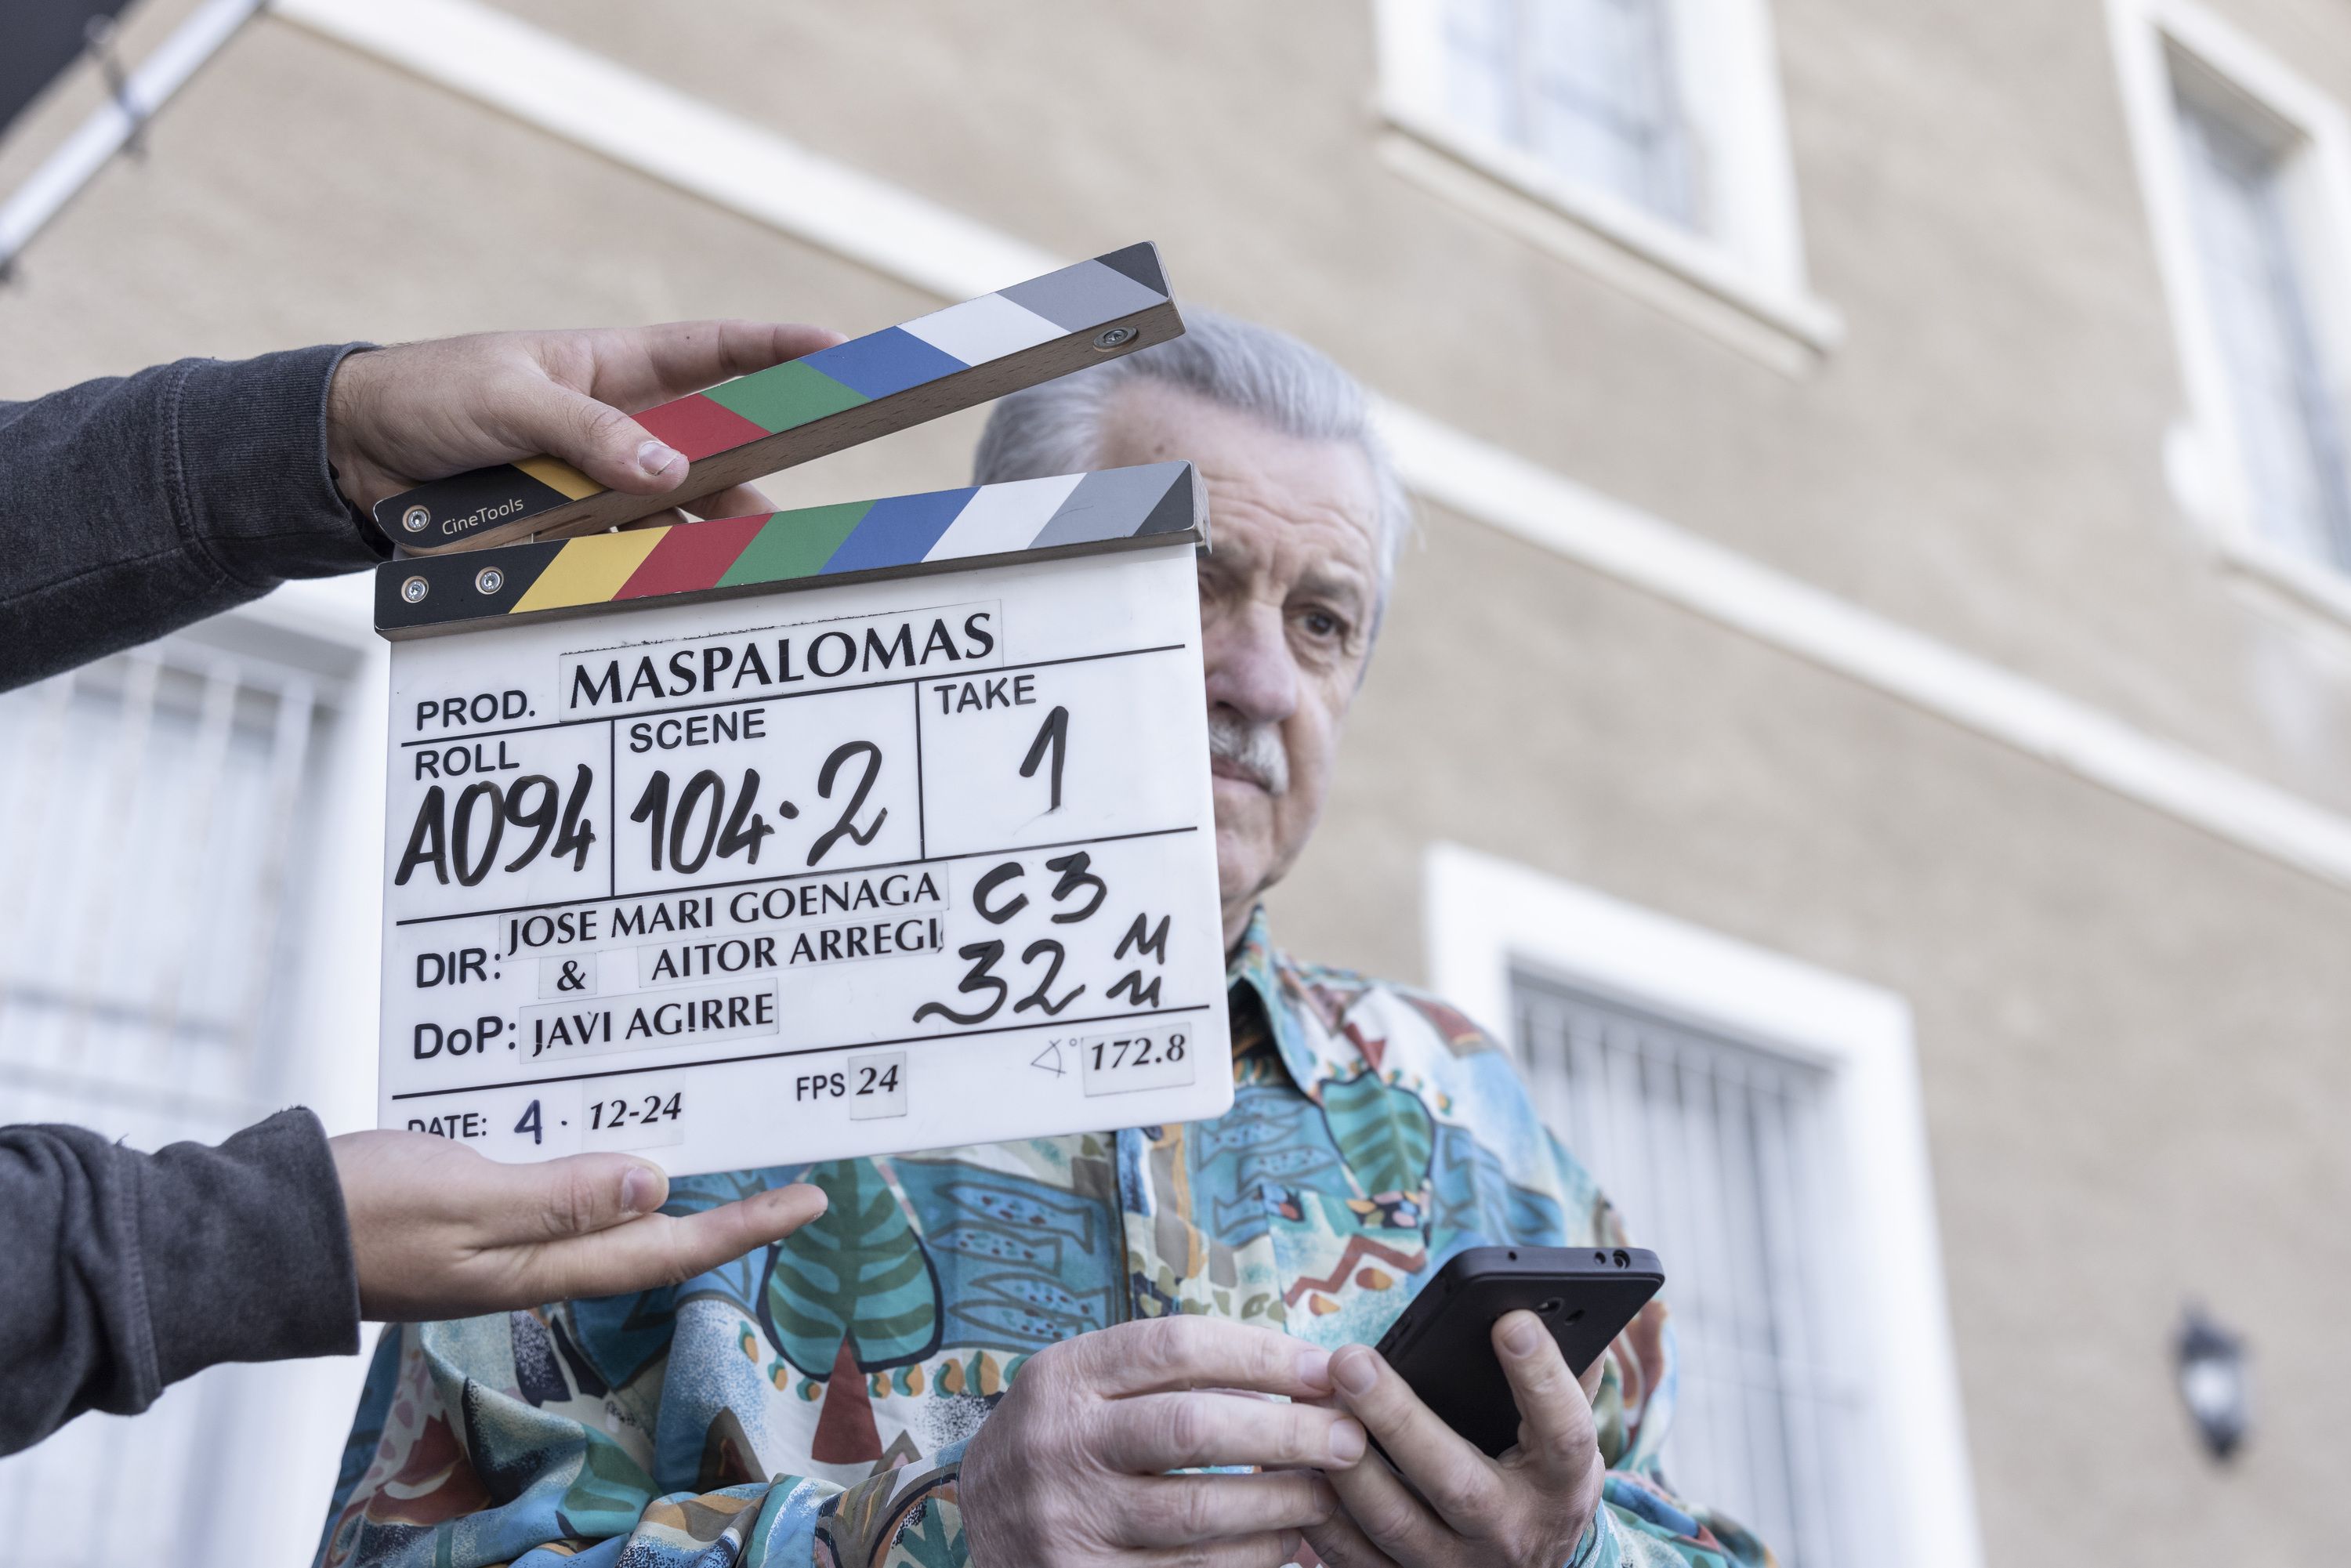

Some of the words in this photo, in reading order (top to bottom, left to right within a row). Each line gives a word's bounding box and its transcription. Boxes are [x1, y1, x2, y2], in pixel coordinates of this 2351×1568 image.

[441, 498, 523, 534] CineTools
[416, 690, 536, 731] PROD.
[570, 612, 994, 709] MASPALOMAS
[933, 674, 1037, 715] TAKE
[629, 708, 766, 753] SCENE
[415, 741, 520, 780] ROLL
[1019, 706, 1069, 814] 1
[394, 763, 596, 885] A094
[507, 910, 597, 956] JOSE
[610, 896, 713, 937] MARI
[729, 872, 940, 923] GOENAGA
[416, 947, 502, 988] DIR:
[556, 960, 586, 991] &
[651, 937, 777, 980] AITOR
[789, 918, 938, 965] ARREGI
[414, 1016, 516, 1059] DoP:
[533, 1012, 611, 1056] JAVI
[625, 993, 773, 1039] AGIRRE
[1090, 1034, 1186, 1071] 172.8
[796, 1072, 846, 1102] FPS
[855, 1064, 899, 1095] 24
[590, 1092, 682, 1130] 12-24
